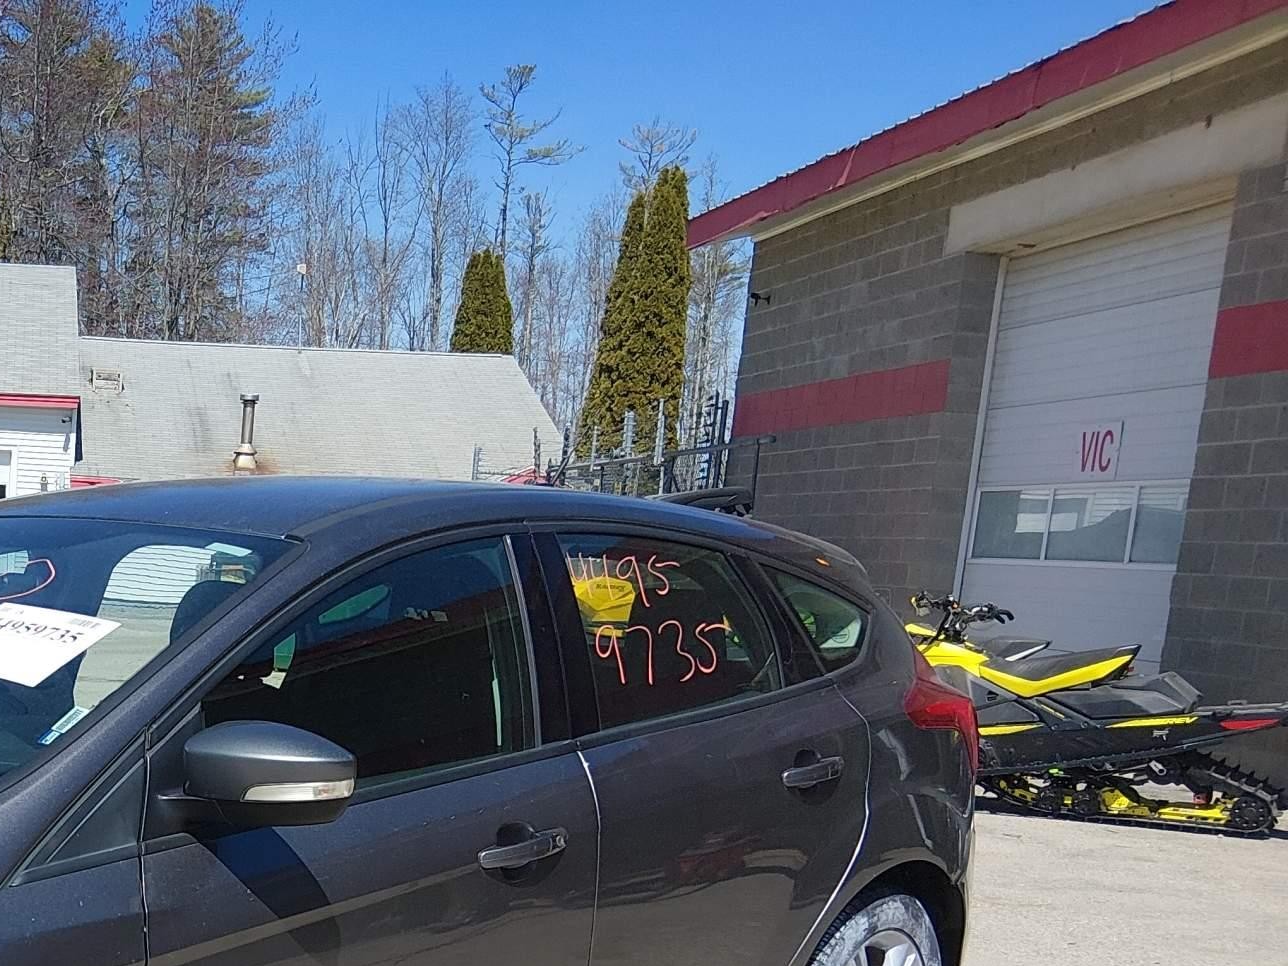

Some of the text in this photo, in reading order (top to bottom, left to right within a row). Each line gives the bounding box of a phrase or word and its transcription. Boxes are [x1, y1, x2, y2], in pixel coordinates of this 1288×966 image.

[1080, 429, 1114, 473] VIC
[565, 552, 681, 607] 4495
[595, 620, 733, 685] 9735
